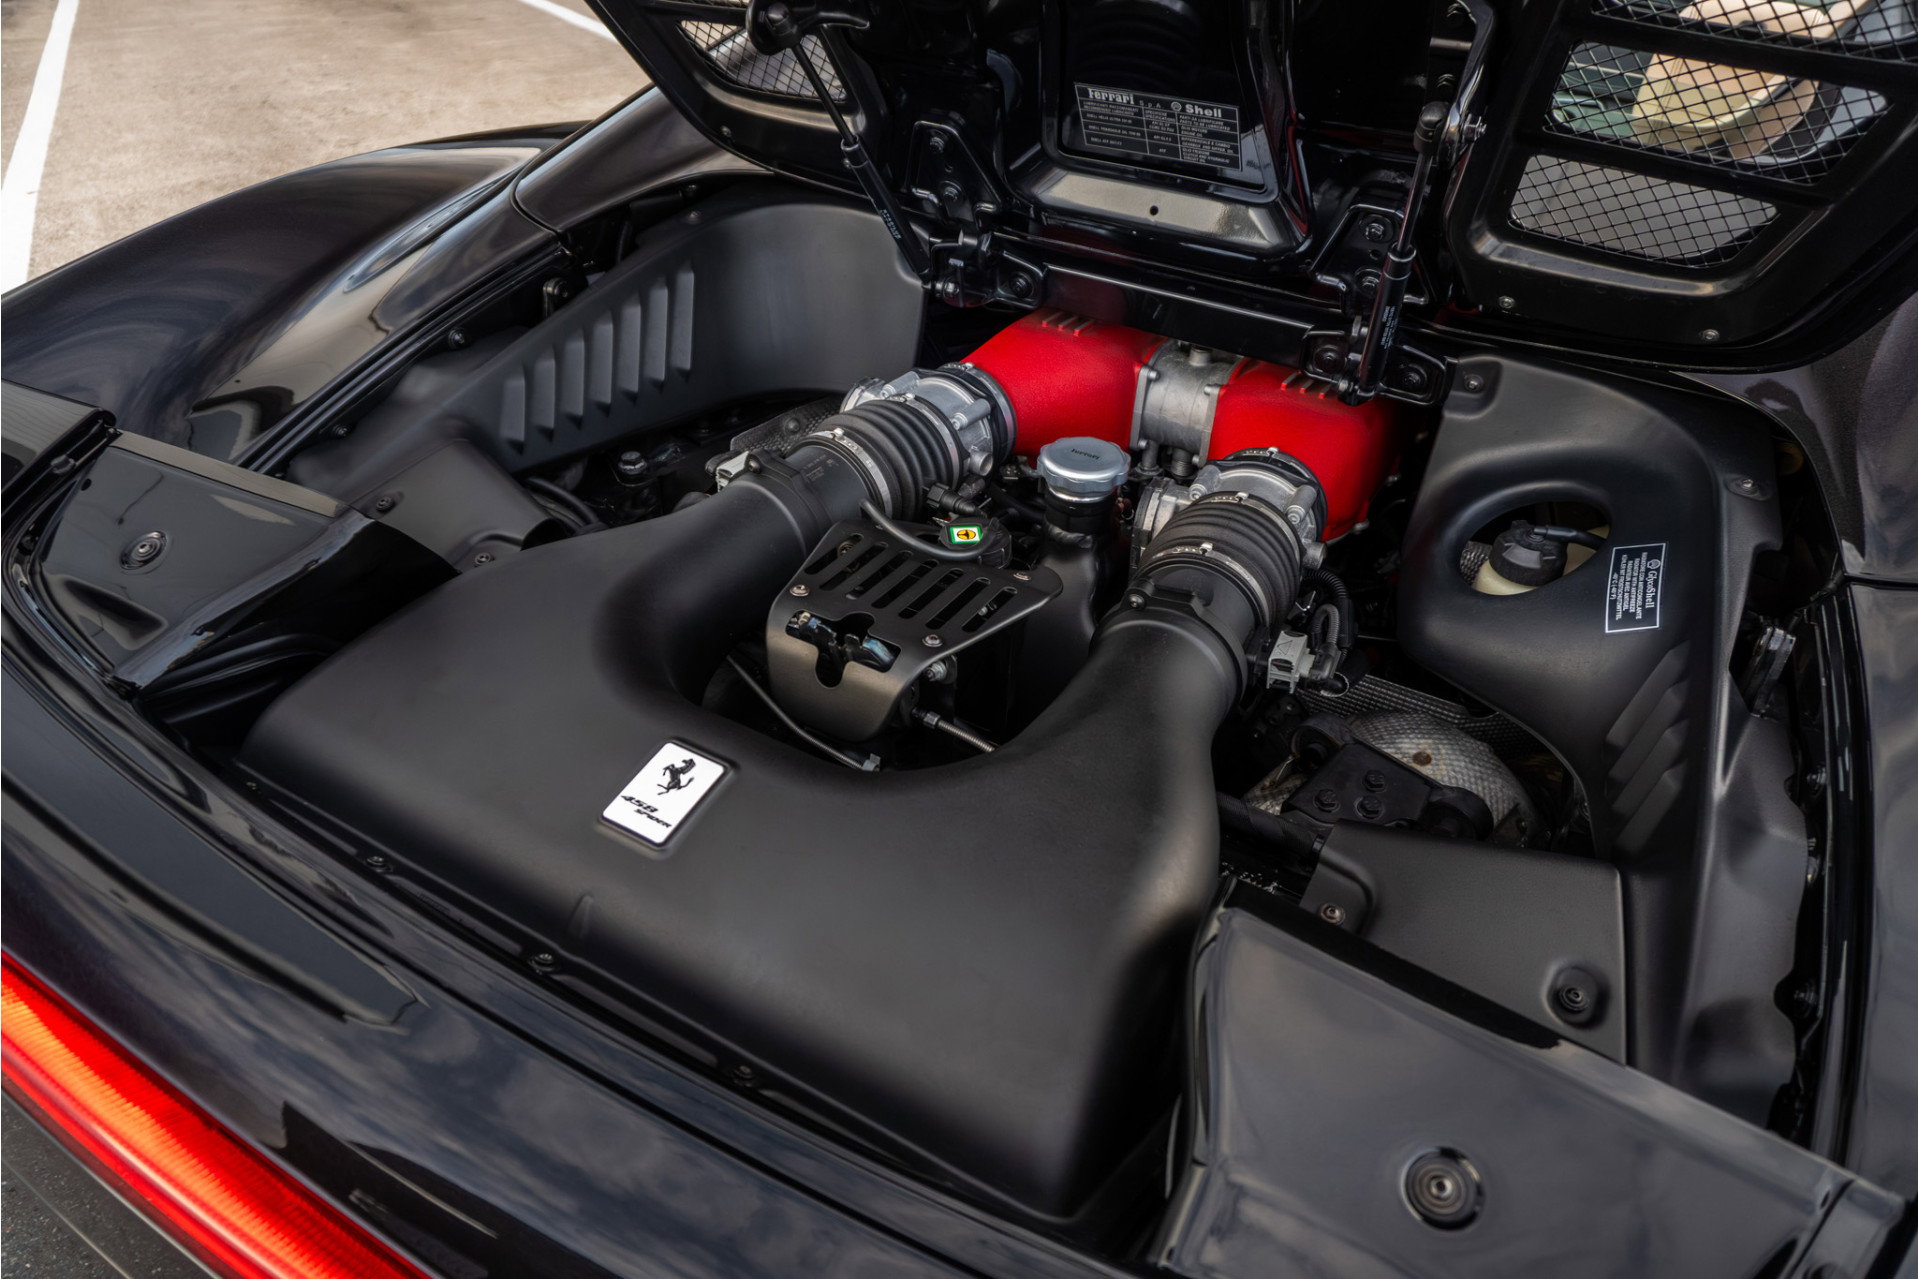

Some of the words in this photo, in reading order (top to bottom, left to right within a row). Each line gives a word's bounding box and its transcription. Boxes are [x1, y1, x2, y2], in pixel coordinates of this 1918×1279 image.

[1087, 88, 1135, 105] Ferrari
[1185, 103, 1222, 118] Shell
[1645, 571, 1657, 608] GlycoShell
[621, 796, 658, 812] 458
[634, 809, 672, 828] SPIDER
